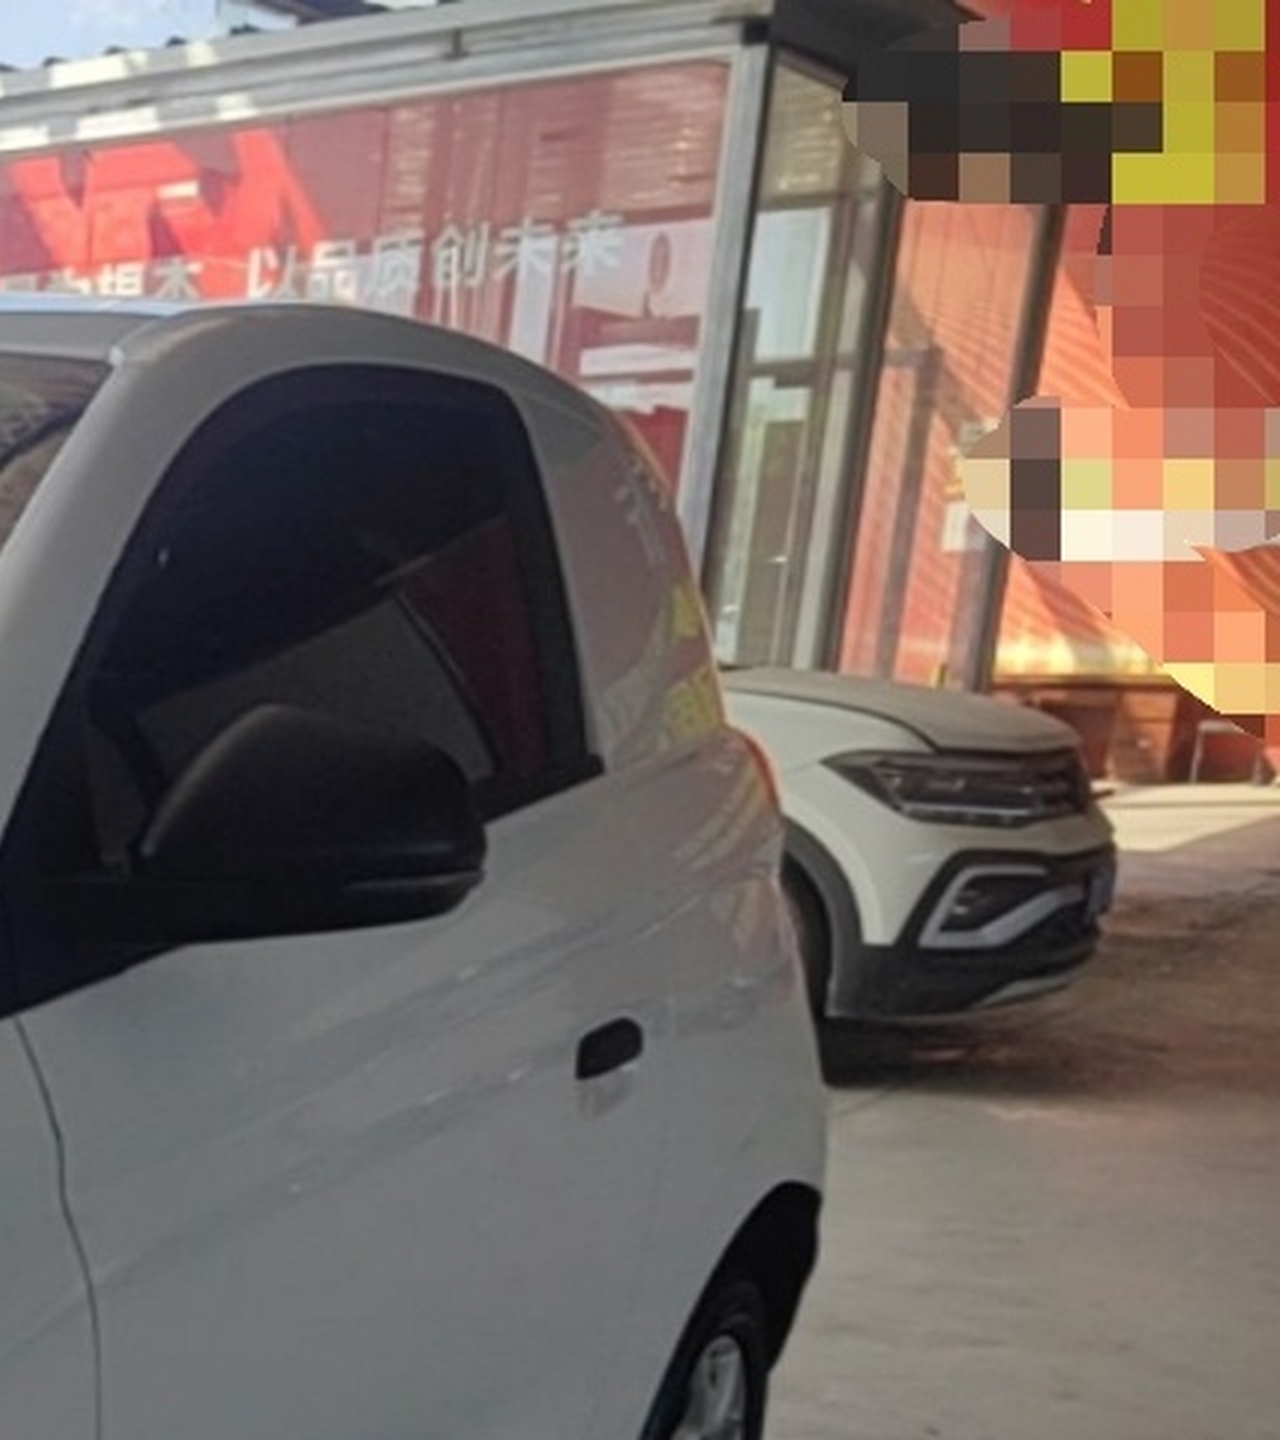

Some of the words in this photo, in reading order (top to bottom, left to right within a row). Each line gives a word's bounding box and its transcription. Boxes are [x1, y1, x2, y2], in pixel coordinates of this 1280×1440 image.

[246, 206, 628, 304] 以品质创未来
